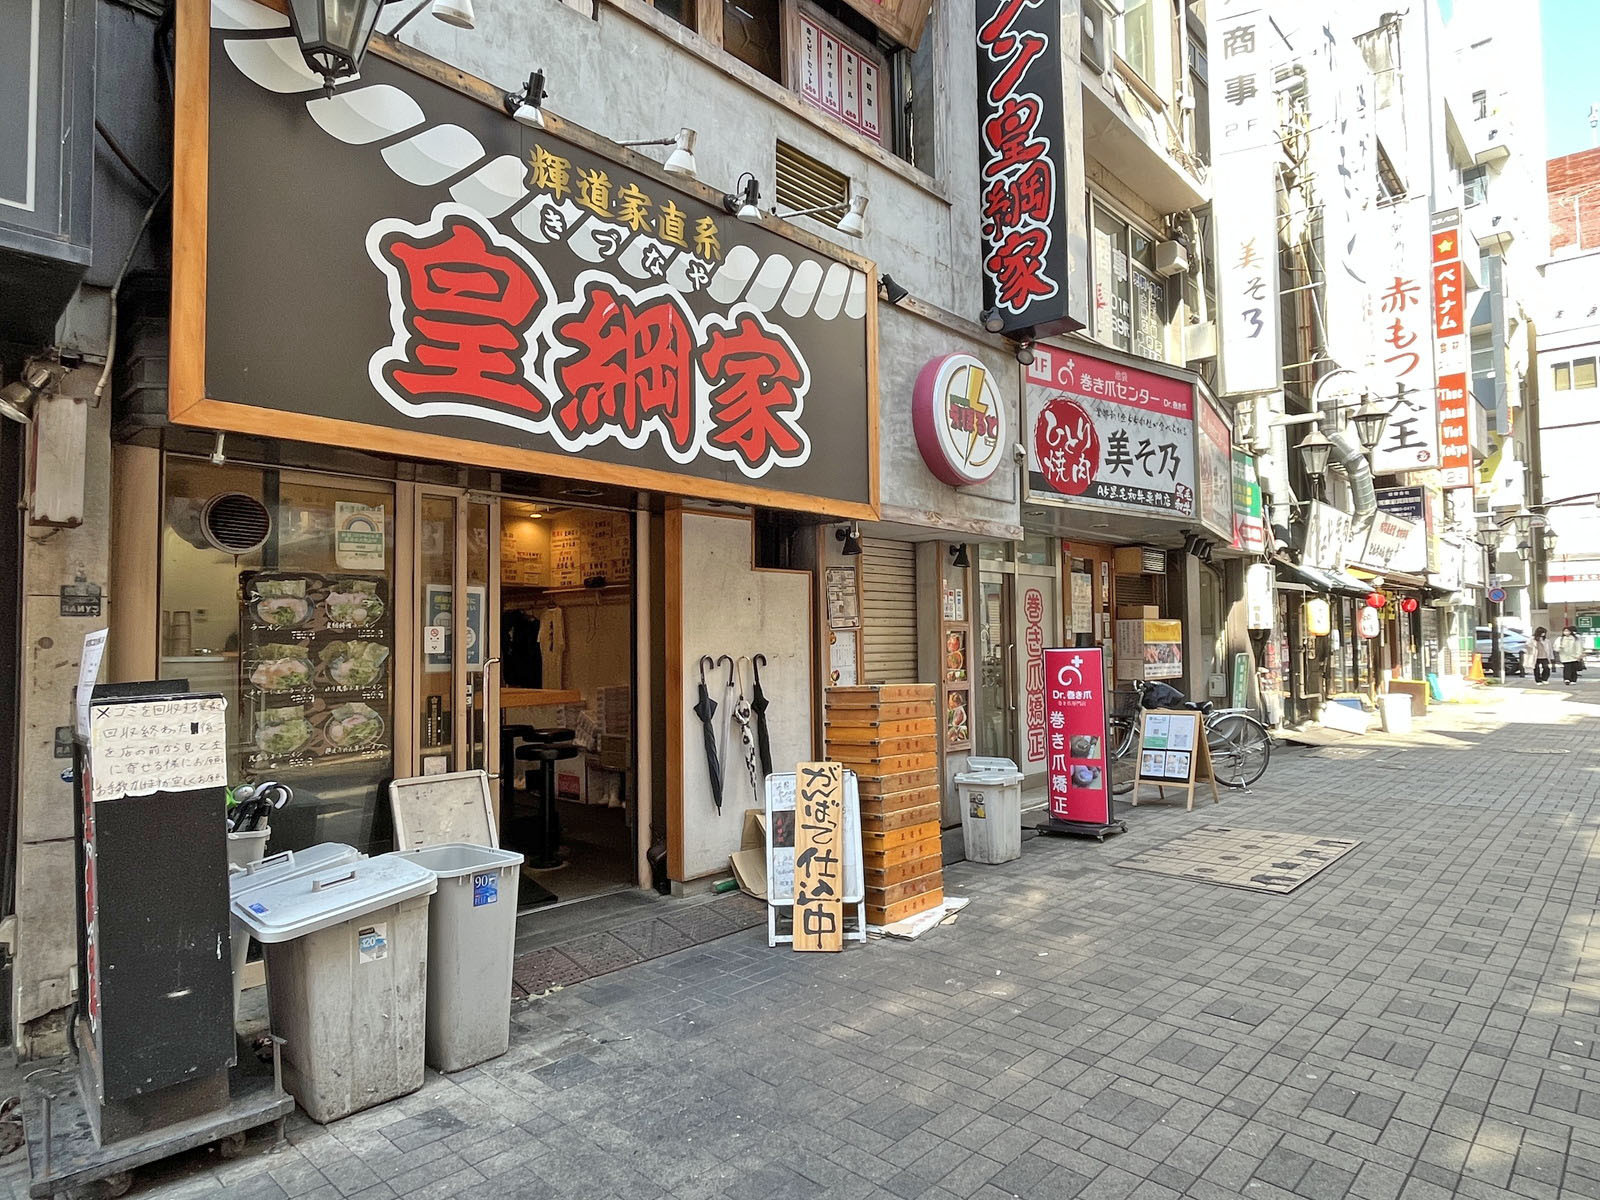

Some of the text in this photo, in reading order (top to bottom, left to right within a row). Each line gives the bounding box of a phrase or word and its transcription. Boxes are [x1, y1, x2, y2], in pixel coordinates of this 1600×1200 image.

[529, 144, 721, 260] 輝道家直系
[1438, 268, 1457, 329] ベトナム
[366, 208, 809, 473] 皇綱家
[1381, 276, 1428, 453] 赤もつ大王
[1080, 373, 1160, 404] 巻き爪センター
[1044, 410, 1091, 455] ひとり
[1105, 428, 1181, 481] 美そ乃
[1043, 450, 1091, 485] 焼肉
[1024, 588, 1047, 763] 巻き爪矯正
[1050, 711, 1068, 815] 巻き爪矯正
[475, 874, 489, 889] 90
